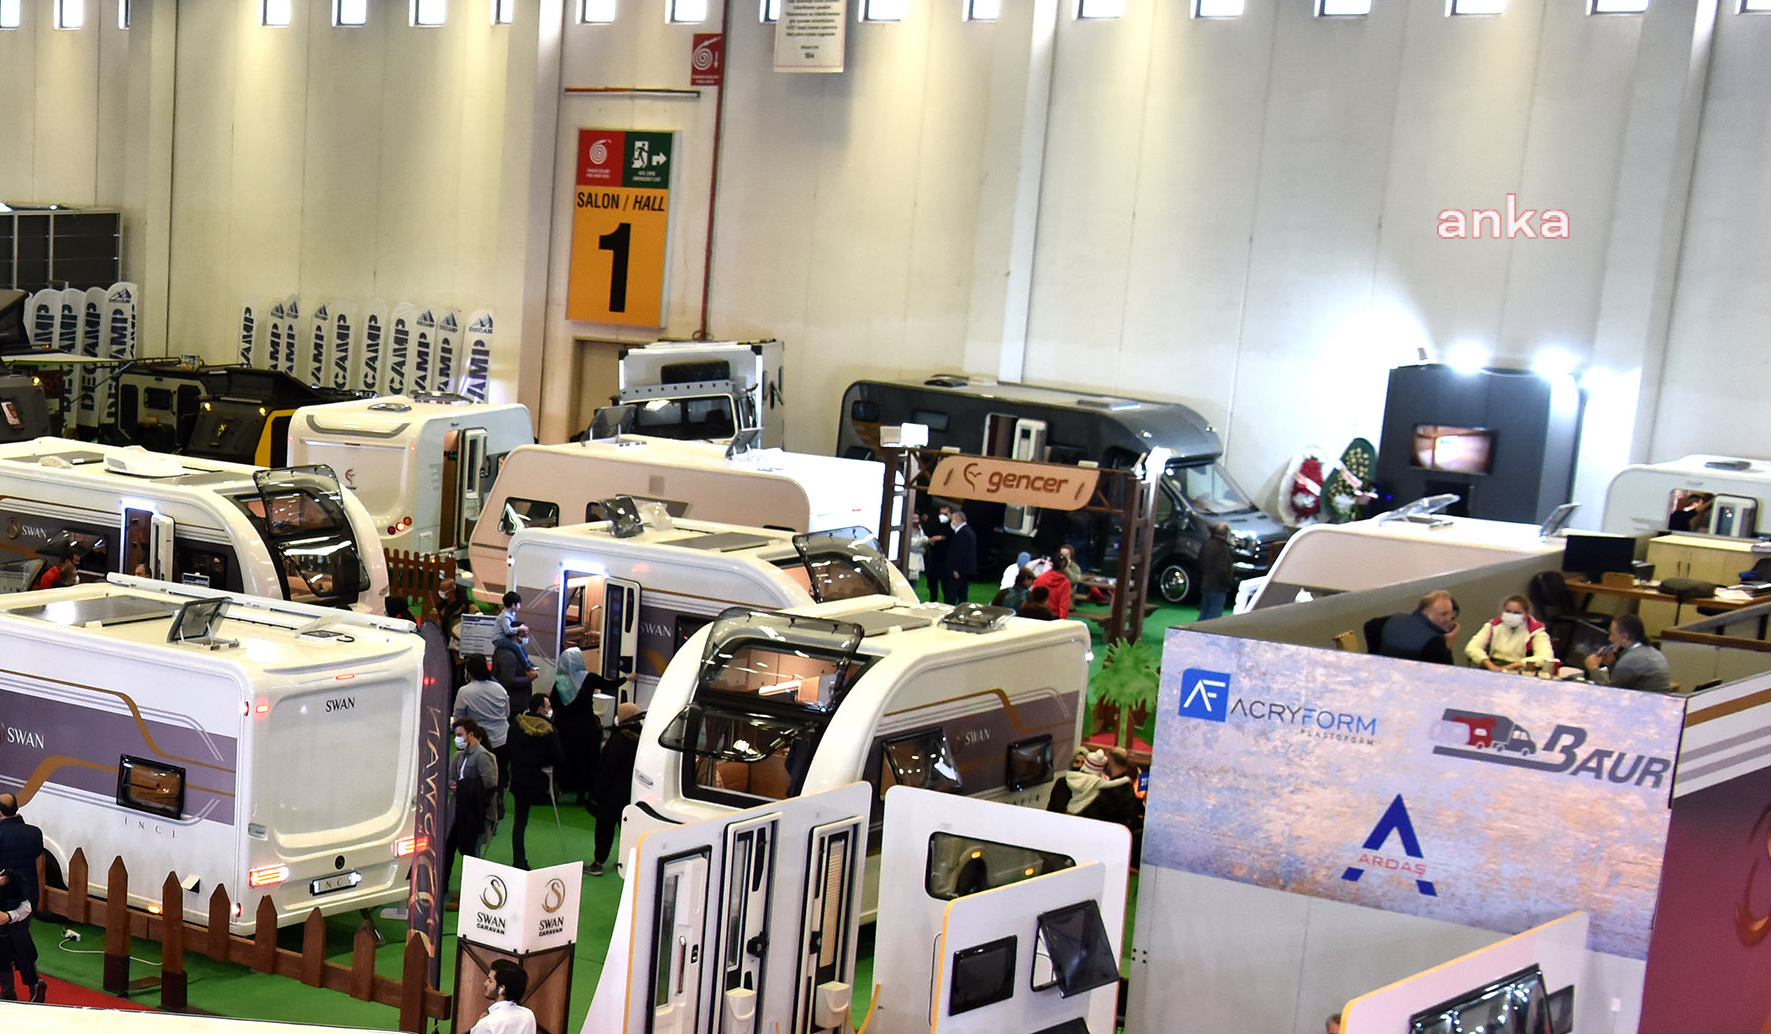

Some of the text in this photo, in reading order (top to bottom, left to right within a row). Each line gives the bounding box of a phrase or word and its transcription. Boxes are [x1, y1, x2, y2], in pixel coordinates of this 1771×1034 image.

[577, 191, 665, 212] SALON / HALL
[597, 222, 632, 313] 1
[311, 325, 324, 384] AMP
[334, 314, 350, 389] CAMP
[363, 314, 381, 389] CAMP
[389, 318, 409, 395] CAMP
[414, 332, 430, 391] AMP
[467, 340, 490, 400] AMP
[986, 470, 1069, 494] gencer
[21, 525, 47, 539] SWAN
[639, 621, 672, 638] SWAN
[325, 697, 356, 712] SWAN
[1230, 698, 1377, 736] ACRYFORM
[7, 726, 45, 750] SWAN
[964, 728, 991, 746] SWAN
[1542, 724, 1672, 790] BAUR
[476, 911, 506, 929] SWAN
[476, 923, 505, 935] CARAVAN
[539, 916, 565, 931] SWAN
